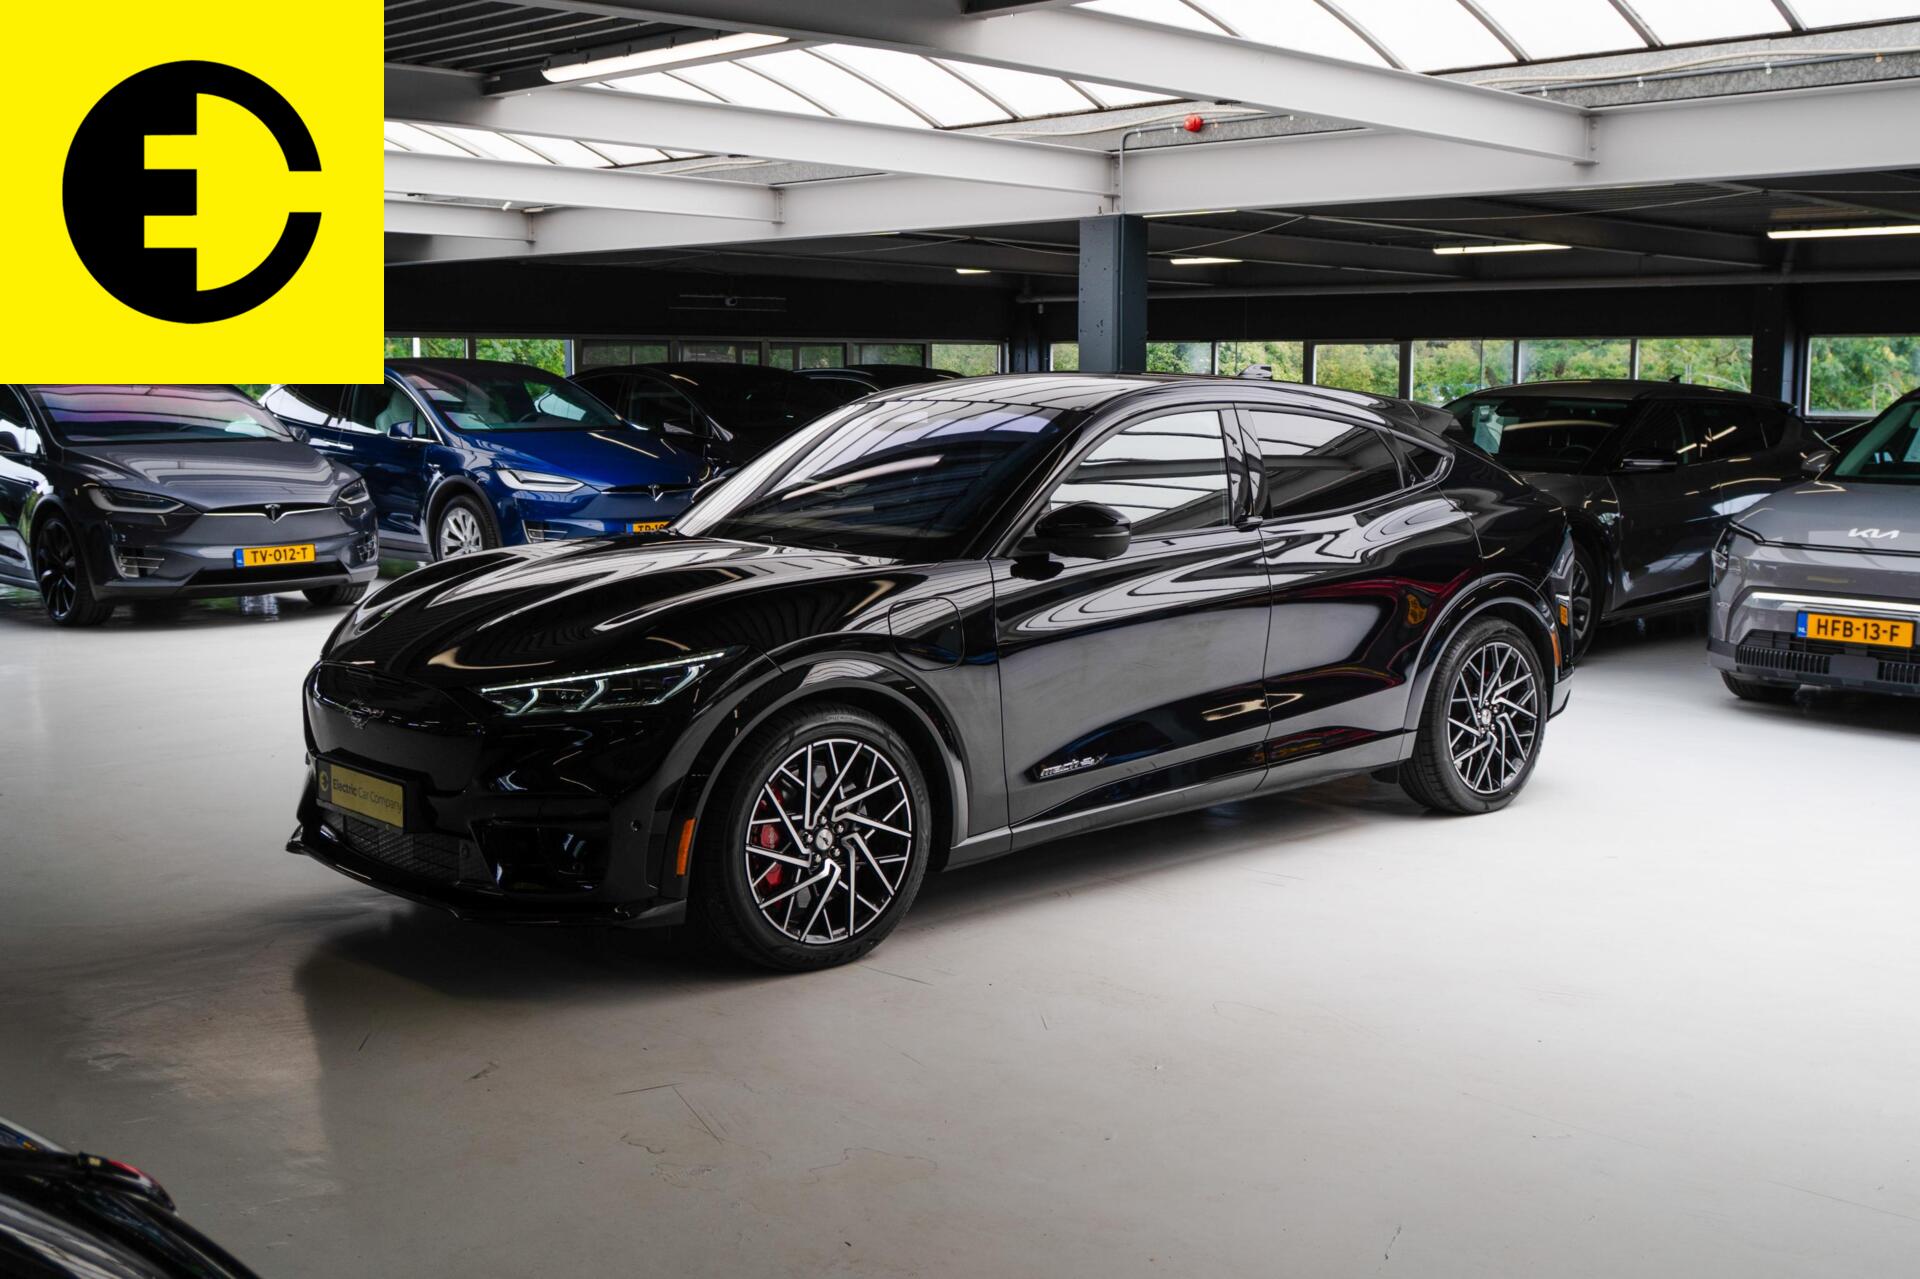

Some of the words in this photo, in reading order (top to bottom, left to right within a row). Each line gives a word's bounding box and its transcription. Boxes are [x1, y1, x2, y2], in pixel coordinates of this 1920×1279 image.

[251, 547, 307, 563] TV-012-T
[1817, 618, 1900, 642] HFB-13-F
[333, 778, 357, 797] Electric
[370, 791, 402, 814] Company
